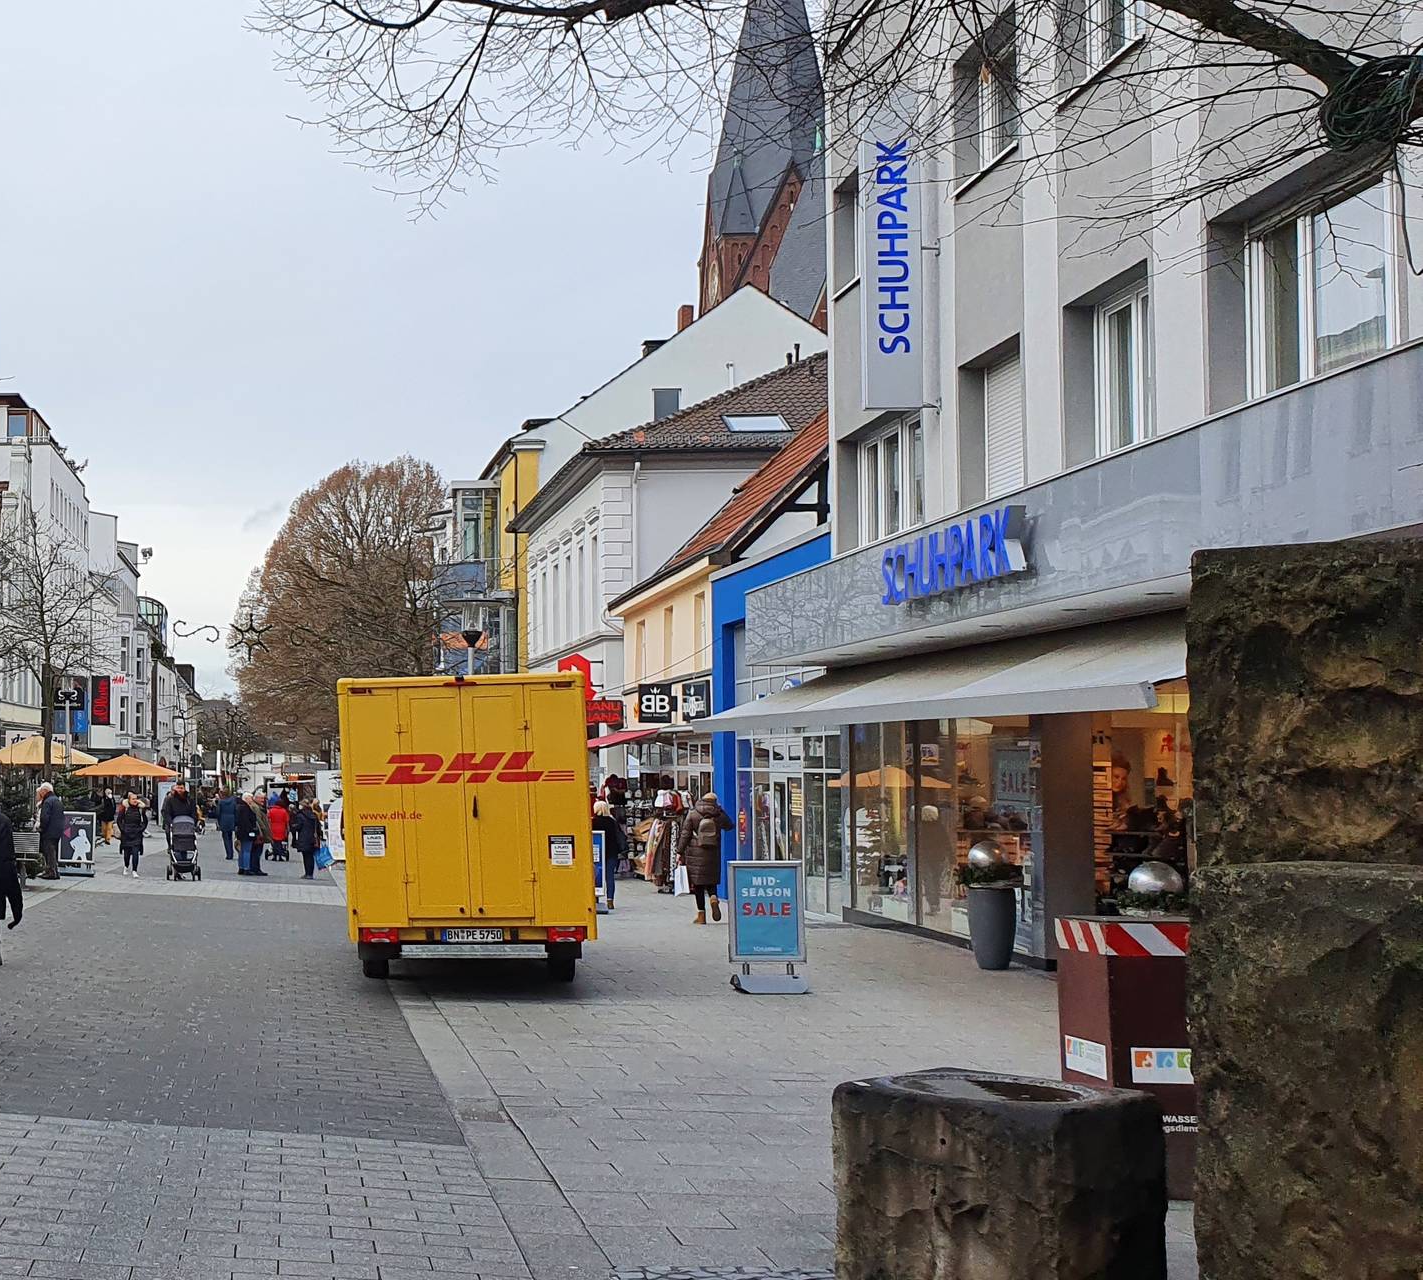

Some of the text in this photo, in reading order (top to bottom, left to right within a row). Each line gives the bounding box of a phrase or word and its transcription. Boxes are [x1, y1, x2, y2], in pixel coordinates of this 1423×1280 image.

[876, 139, 910, 354] SCHUHPARK
[882, 506, 1012, 606] SCHUHPARK
[385, 751, 544, 784] DHL
[359, 811, 422, 820] www.dhl.de
[752, 876, 781, 886] MID-
[741, 887, 791, 897] SEASON
[742, 902, 792, 917] SALE
[447, 929, 502, 940] BN PE 5750
